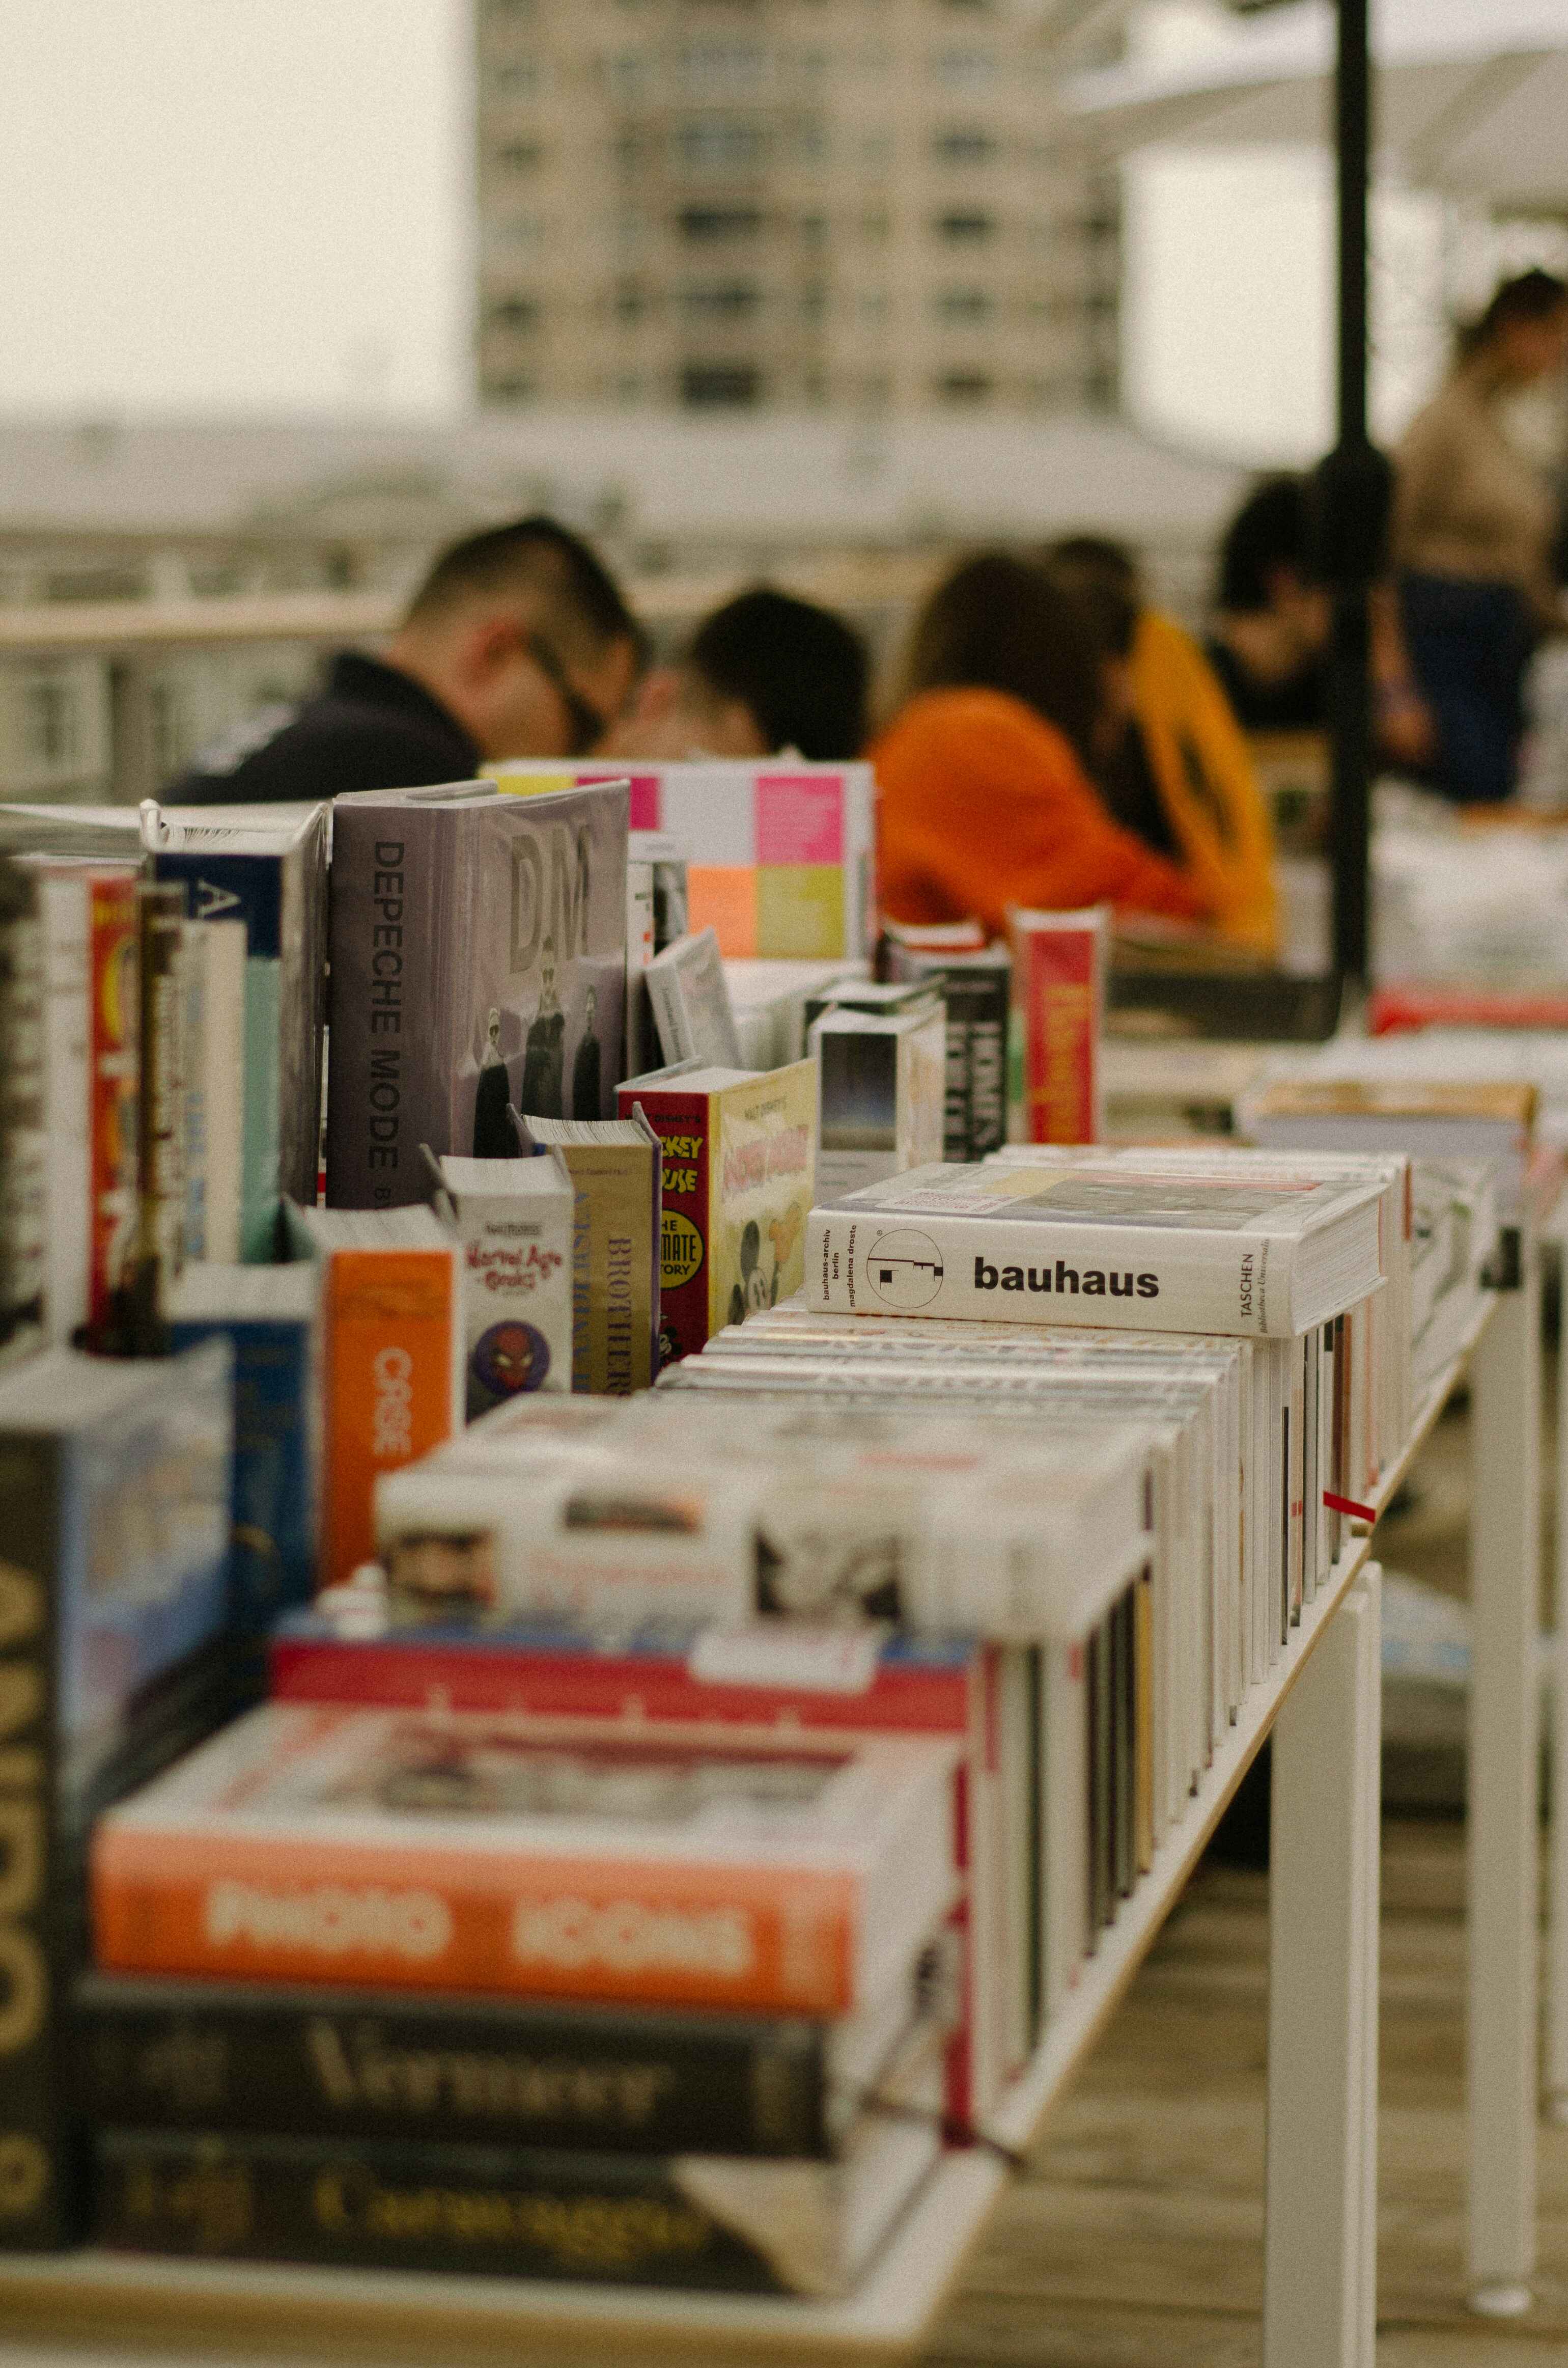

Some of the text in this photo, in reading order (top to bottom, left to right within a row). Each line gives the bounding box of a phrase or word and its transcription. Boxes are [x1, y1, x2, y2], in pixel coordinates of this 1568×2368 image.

[372, 841, 405, 1033] DEPECHE
[369, 1049, 401, 1169] MODE
[659, 1135, 704, 1160] CKEY
[661, 1220, 678, 1231] HE
[822, 1229, 831, 1301] bauhaus-archiv
[847, 1225, 857, 1307] magdalena droste
[974, 1256, 1159, 1298] bauhaus
[1240, 1253, 1254, 1318] TASCHEN
[1257, 1288, 1268, 1334] Bibliotheca
